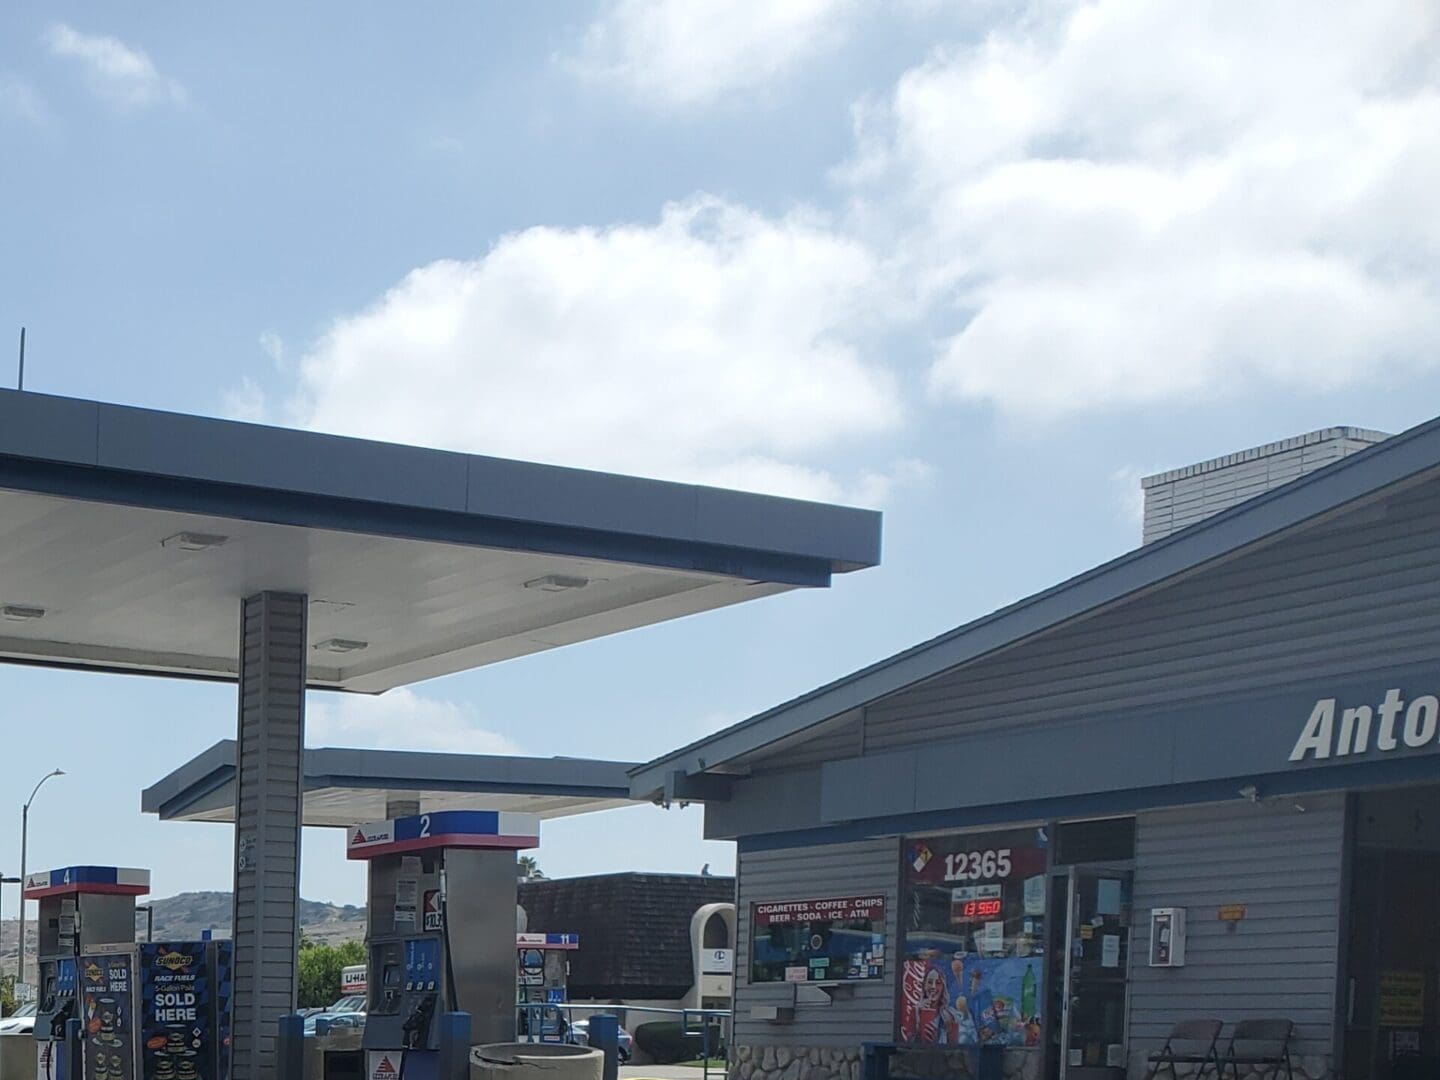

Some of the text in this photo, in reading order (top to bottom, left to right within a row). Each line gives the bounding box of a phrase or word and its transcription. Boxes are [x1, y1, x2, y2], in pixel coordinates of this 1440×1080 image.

[1288, 688, 1440, 762] Anto
[419, 814, 431, 838] 2
[944, 849, 1012, 881] 12365
[63, 868, 70, 886] 4
[757, 903, 809, 914] CIGARETTES
[815, 900, 848, 910] COFFEE
[855, 898, 883, 908] CHIPS
[769, 914, 791, 923] BEER
[797, 912, 821, 921] SODA
[828, 910, 843, 919] ICE
[849, 909, 870, 919] ATM
[109, 969, 127, 980] SOLD
[110, 981, 128, 992] HERE
[155, 993, 196, 1006] SOLD
[155, 1008, 197, 1021] HERE
